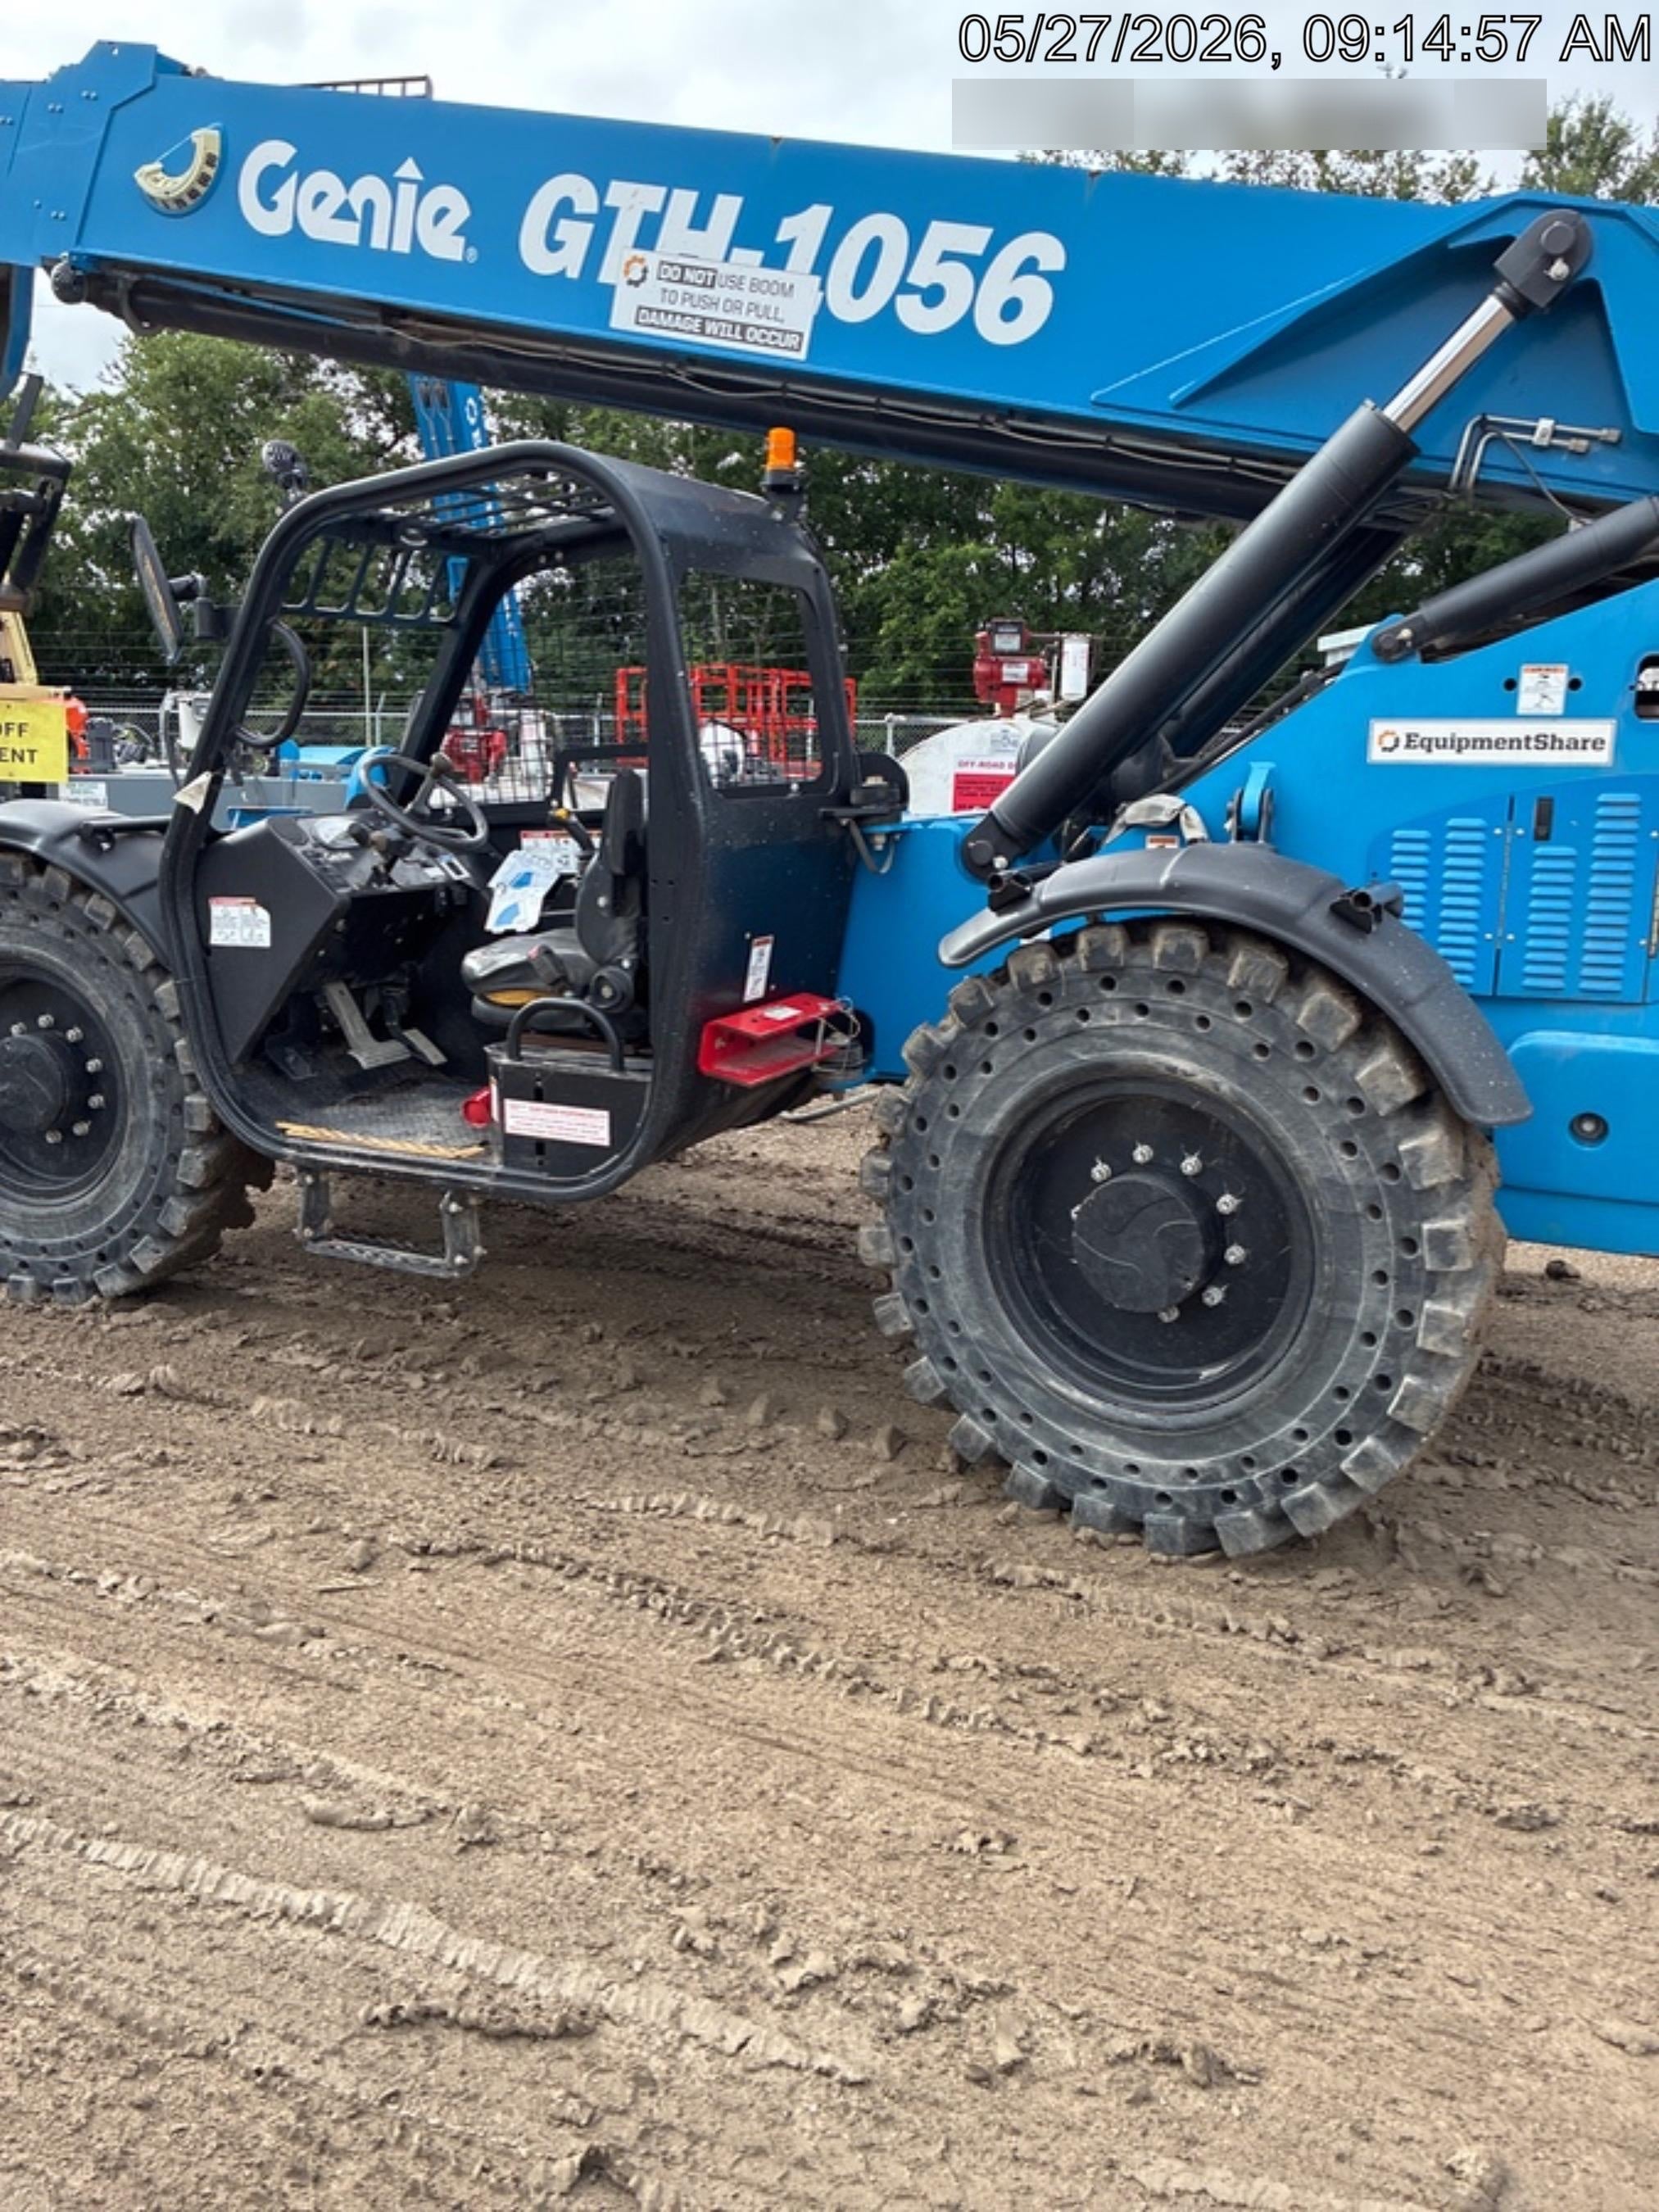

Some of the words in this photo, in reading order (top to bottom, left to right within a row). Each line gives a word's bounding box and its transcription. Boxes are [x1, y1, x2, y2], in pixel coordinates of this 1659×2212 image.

[238, 138, 472, 262] Genie
[518, 172, 1067, 346] GTH-1056
[659, 263, 683, 282] DO
[683, 267, 715, 288] NOT
[718, 273, 746, 292] USE
[748, 277, 795, 298] BOOM
[660, 288, 678, 306] TO
[681, 291, 718, 312] PUSH
[722, 296, 743, 315] OR
[637, 308, 703, 333] DAMAGE
[703, 319, 744, 342] WILL
[746, 325, 802, 350] OCCUR
[0, 722, 29, 738] FF
[1403, 732, 1607, 754] EquipmentShare
